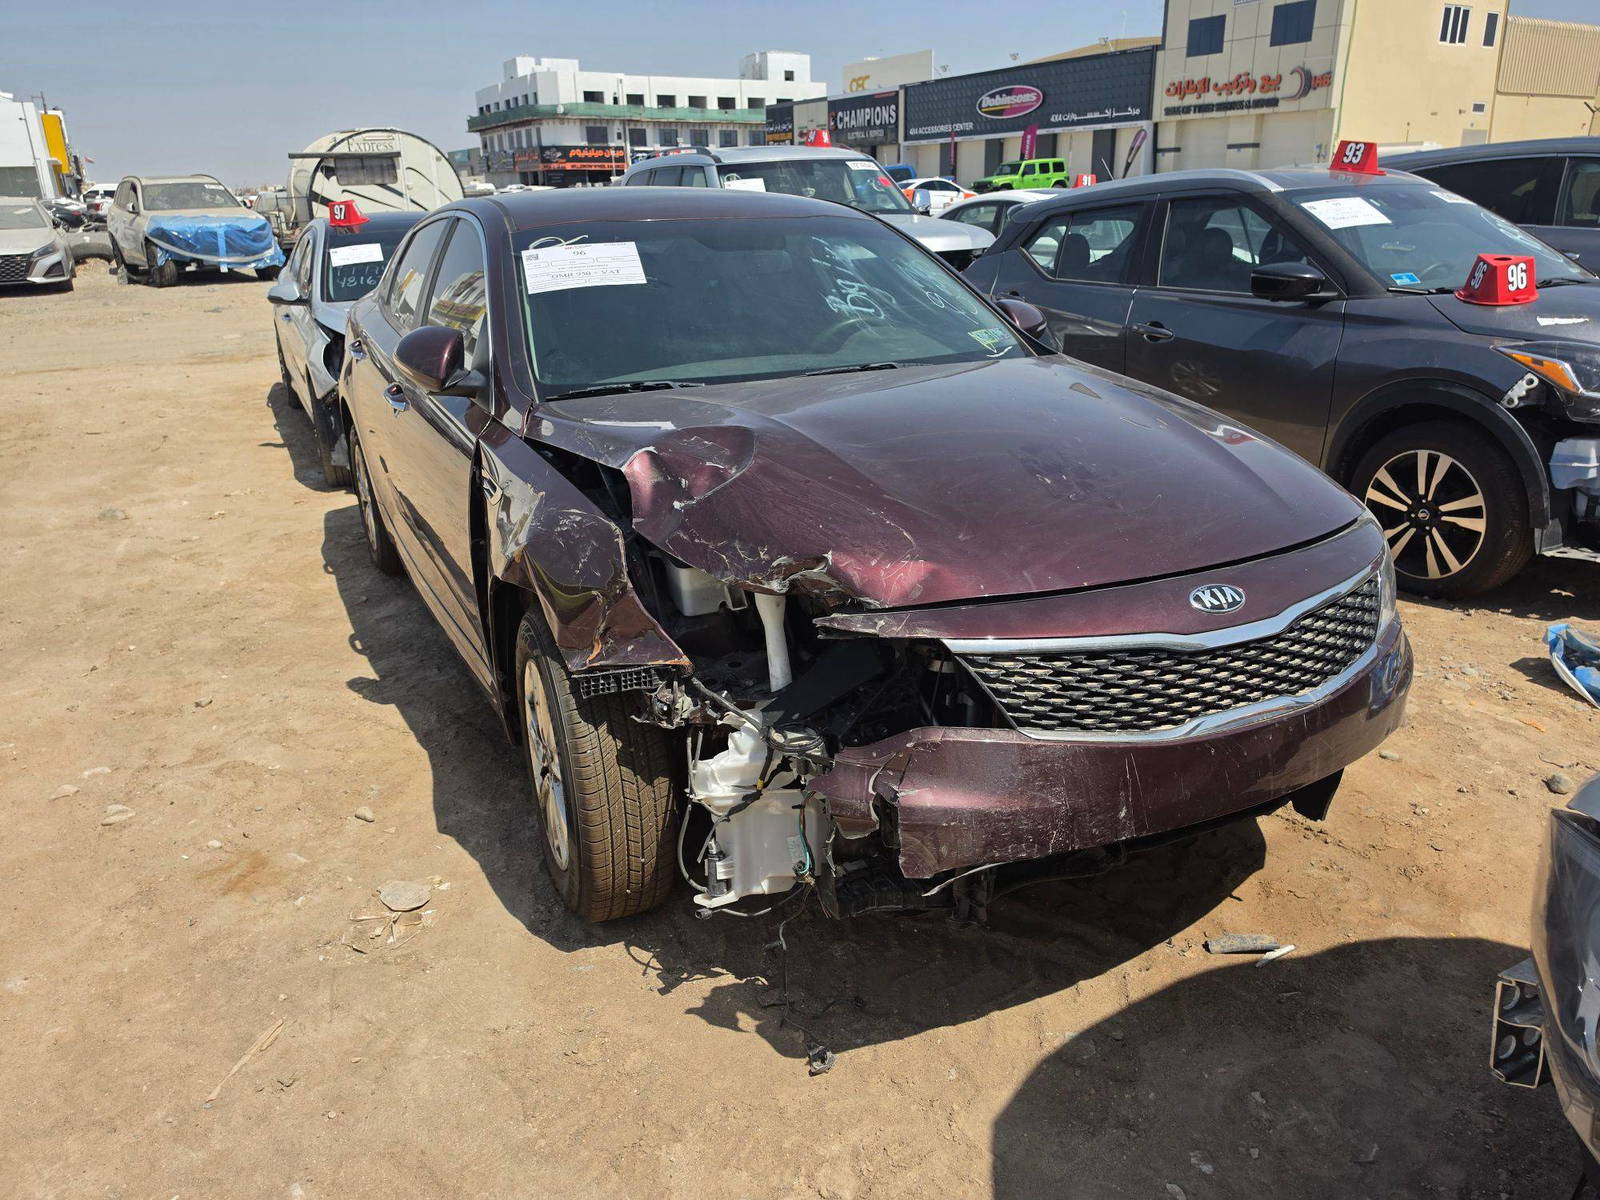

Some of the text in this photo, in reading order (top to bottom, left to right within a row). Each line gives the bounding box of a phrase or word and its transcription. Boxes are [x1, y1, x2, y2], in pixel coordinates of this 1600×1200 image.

[982, 91, 1038, 107] Dobinsons
[837, 104, 896, 129] CHAMPIONS
[919, 123, 952, 135] ACCESSORIES
[953, 121, 974, 131] CENTER
[348, 138, 393, 152] Express
[1342, 142, 1364, 164] 93
[1082, 175, 1091, 186] 91
[334, 204, 346, 220] 97
[1471, 261, 1488, 290] 96
[1507, 263, 1527, 291] 96
[1195, 587, 1241, 608] KIA
